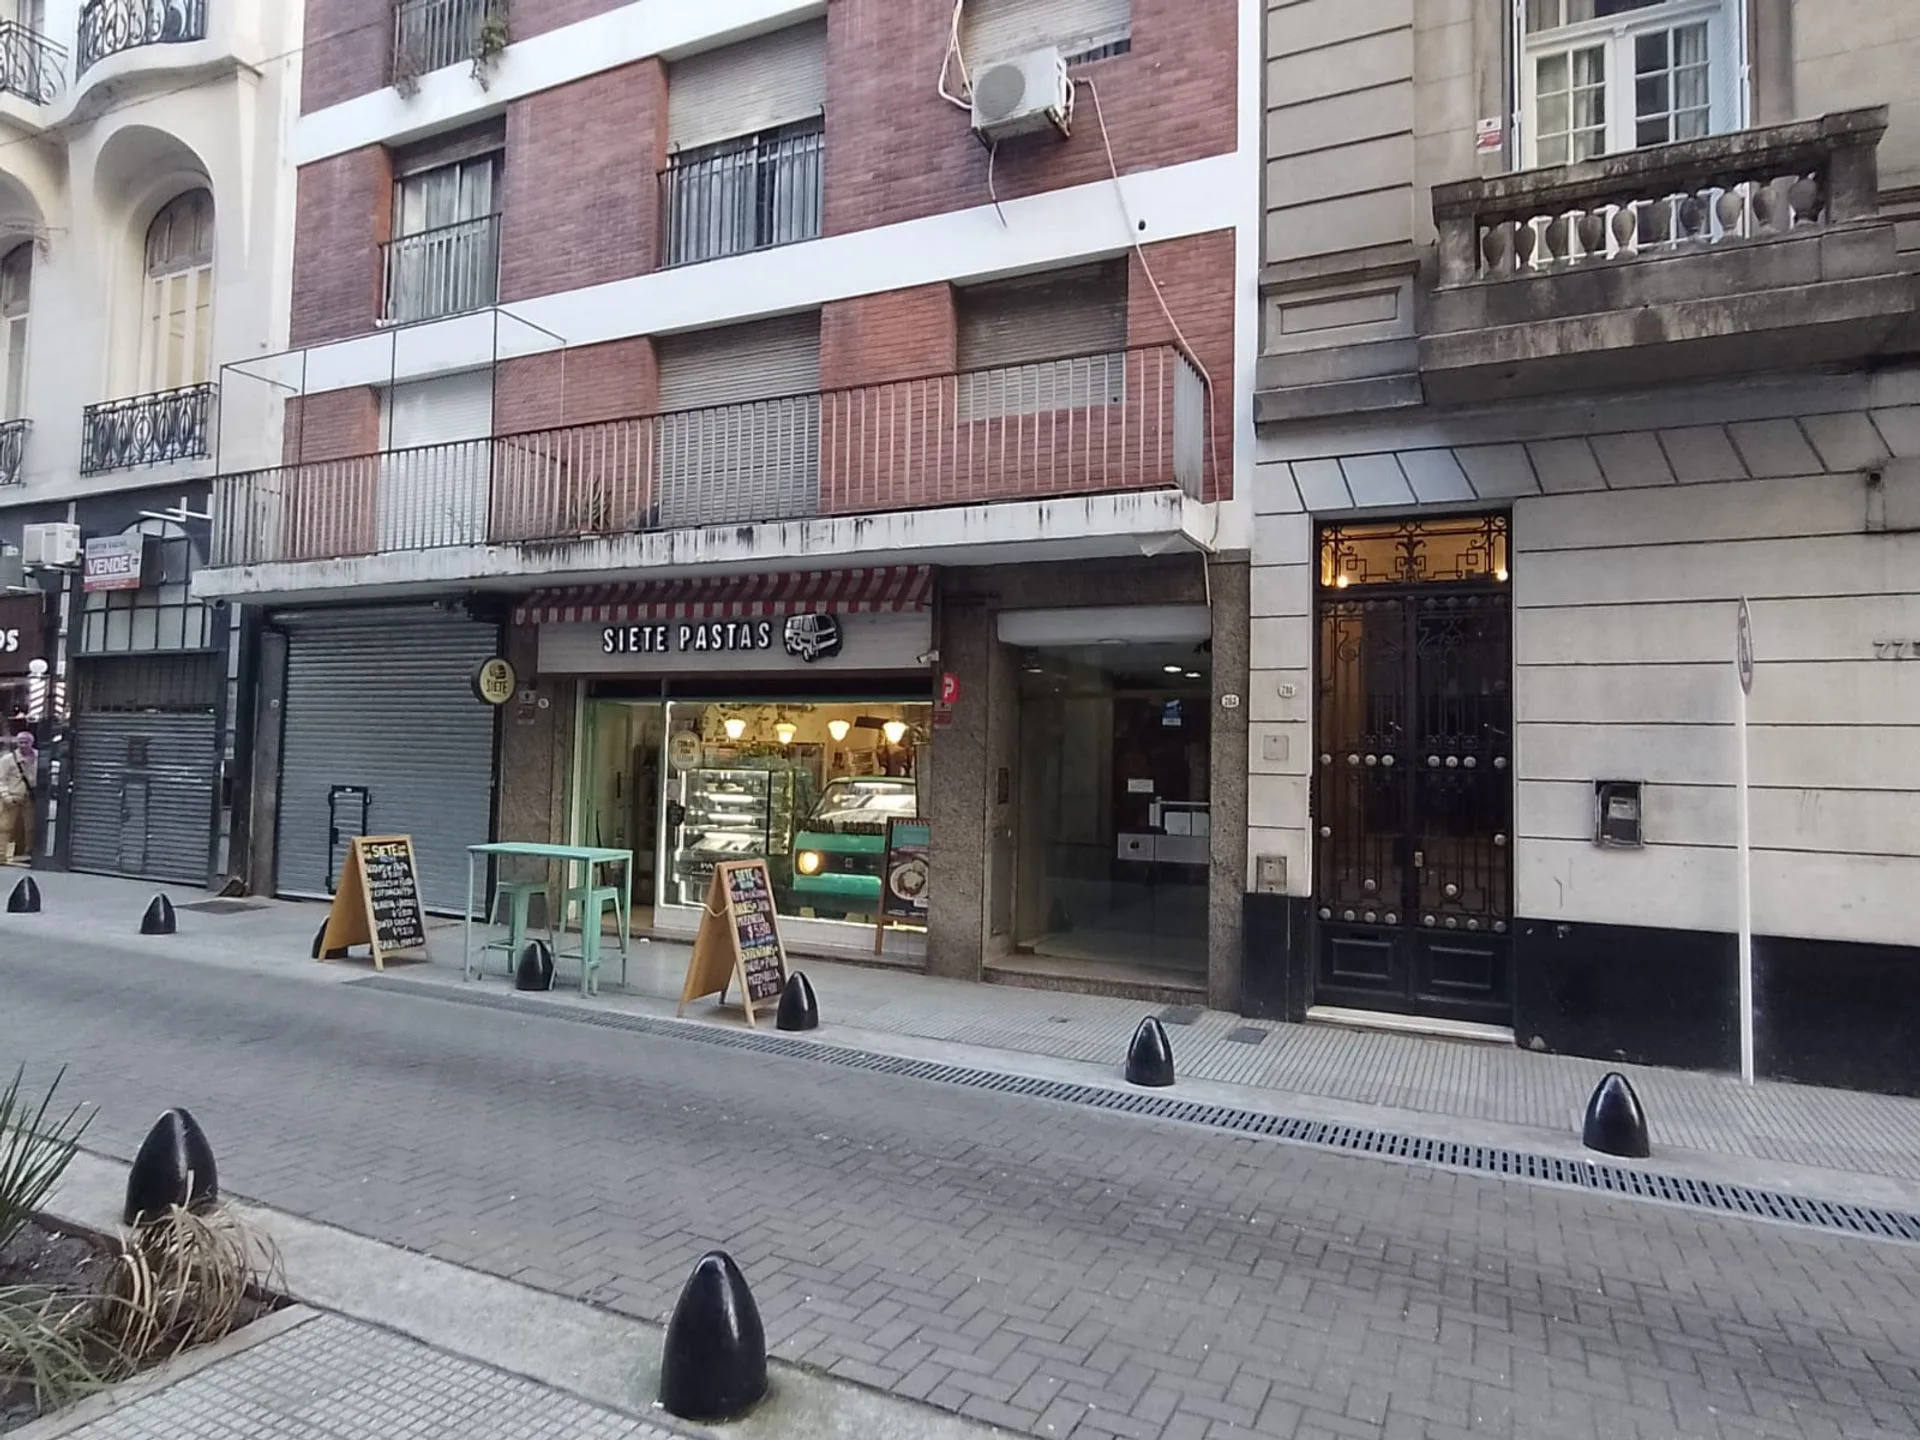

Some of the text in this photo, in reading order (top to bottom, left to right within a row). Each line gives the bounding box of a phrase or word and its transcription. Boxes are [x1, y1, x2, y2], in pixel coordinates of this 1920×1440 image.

[88, 555, 131, 575] VENDE
[603, 621, 770, 653] SIETE PASTAS
